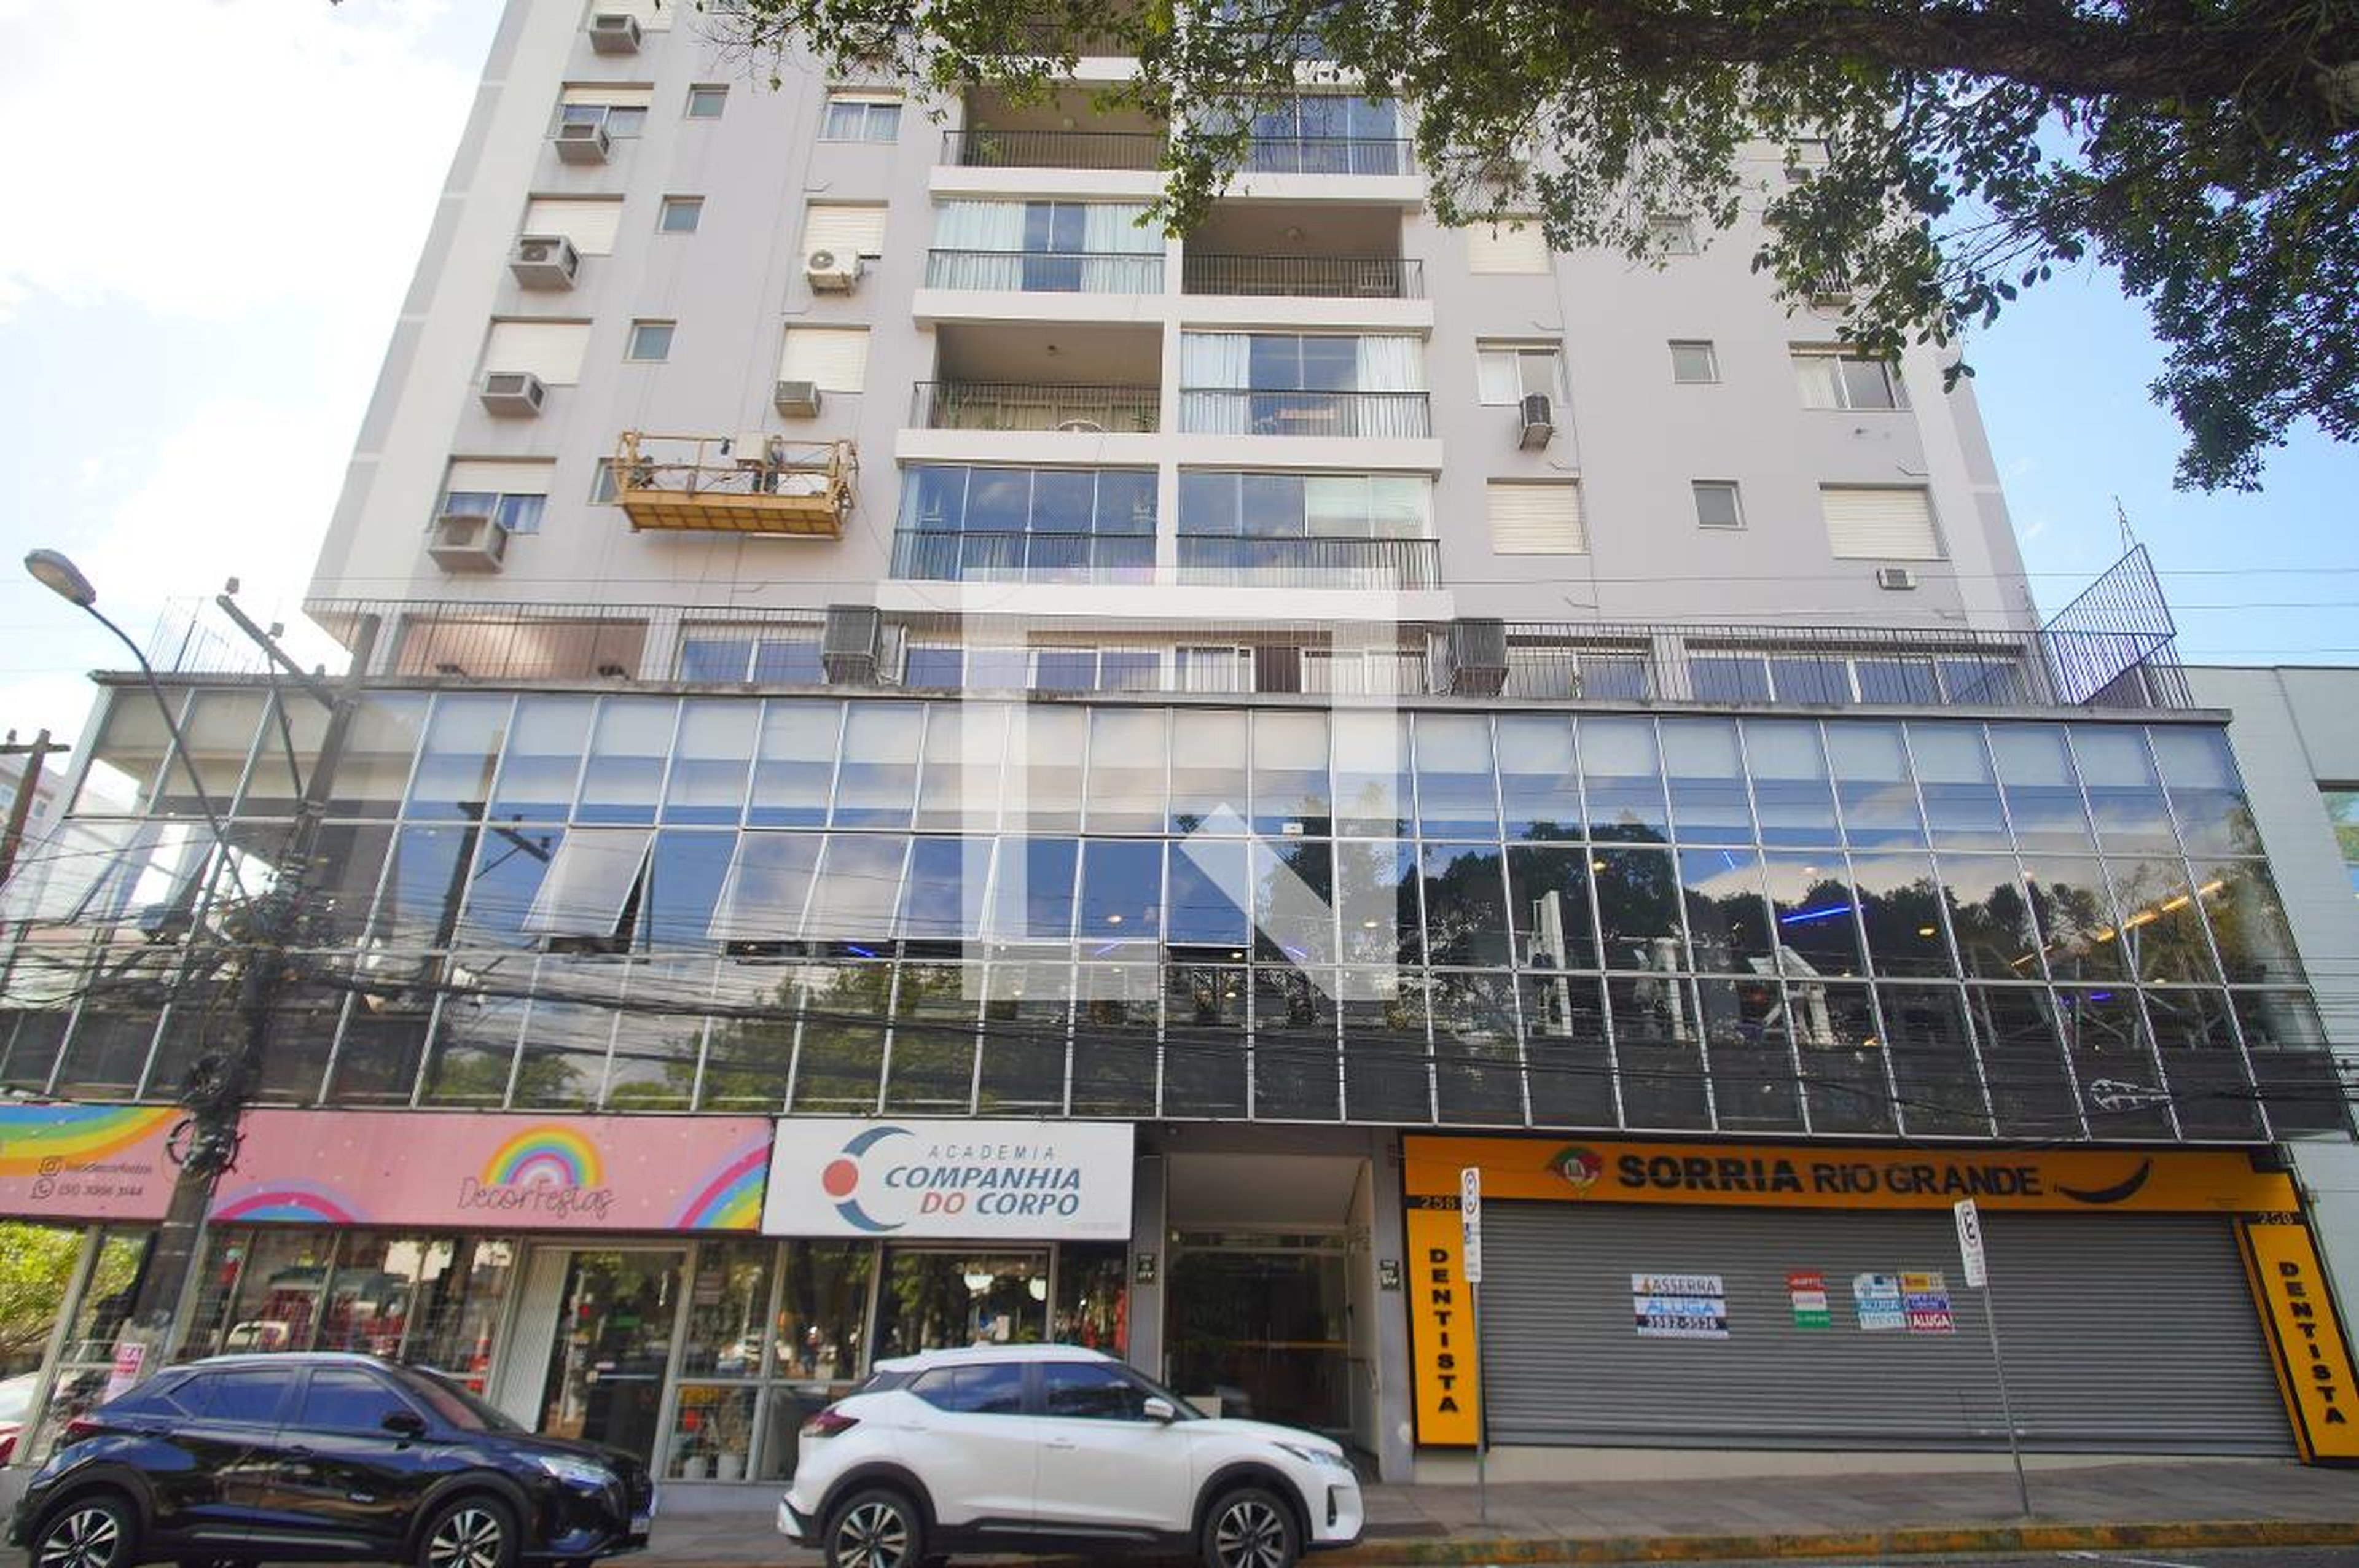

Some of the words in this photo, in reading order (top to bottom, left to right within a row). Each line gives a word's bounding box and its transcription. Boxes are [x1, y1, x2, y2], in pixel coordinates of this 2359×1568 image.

[928, 1144, 1056, 1160] ACADEMIA
[885, 1166, 1080, 1190] COMPANHIA
[1617, 1155, 1803, 1193] SORRIA
[1811, 1163, 1879, 1193] RIO
[1885, 1163, 2043, 1196] GRANDE
[920, 1192, 966, 1214] DO
[976, 1192, 1080, 1216] CORPO
[1646, 1300, 1716, 1315] ALUGA
[1430, 1249, 1458, 1413] DENTISTA
[1912, 1314, 1952, 1328] ALUGA
[2279, 1261, 2347, 1425] DENTISTA
